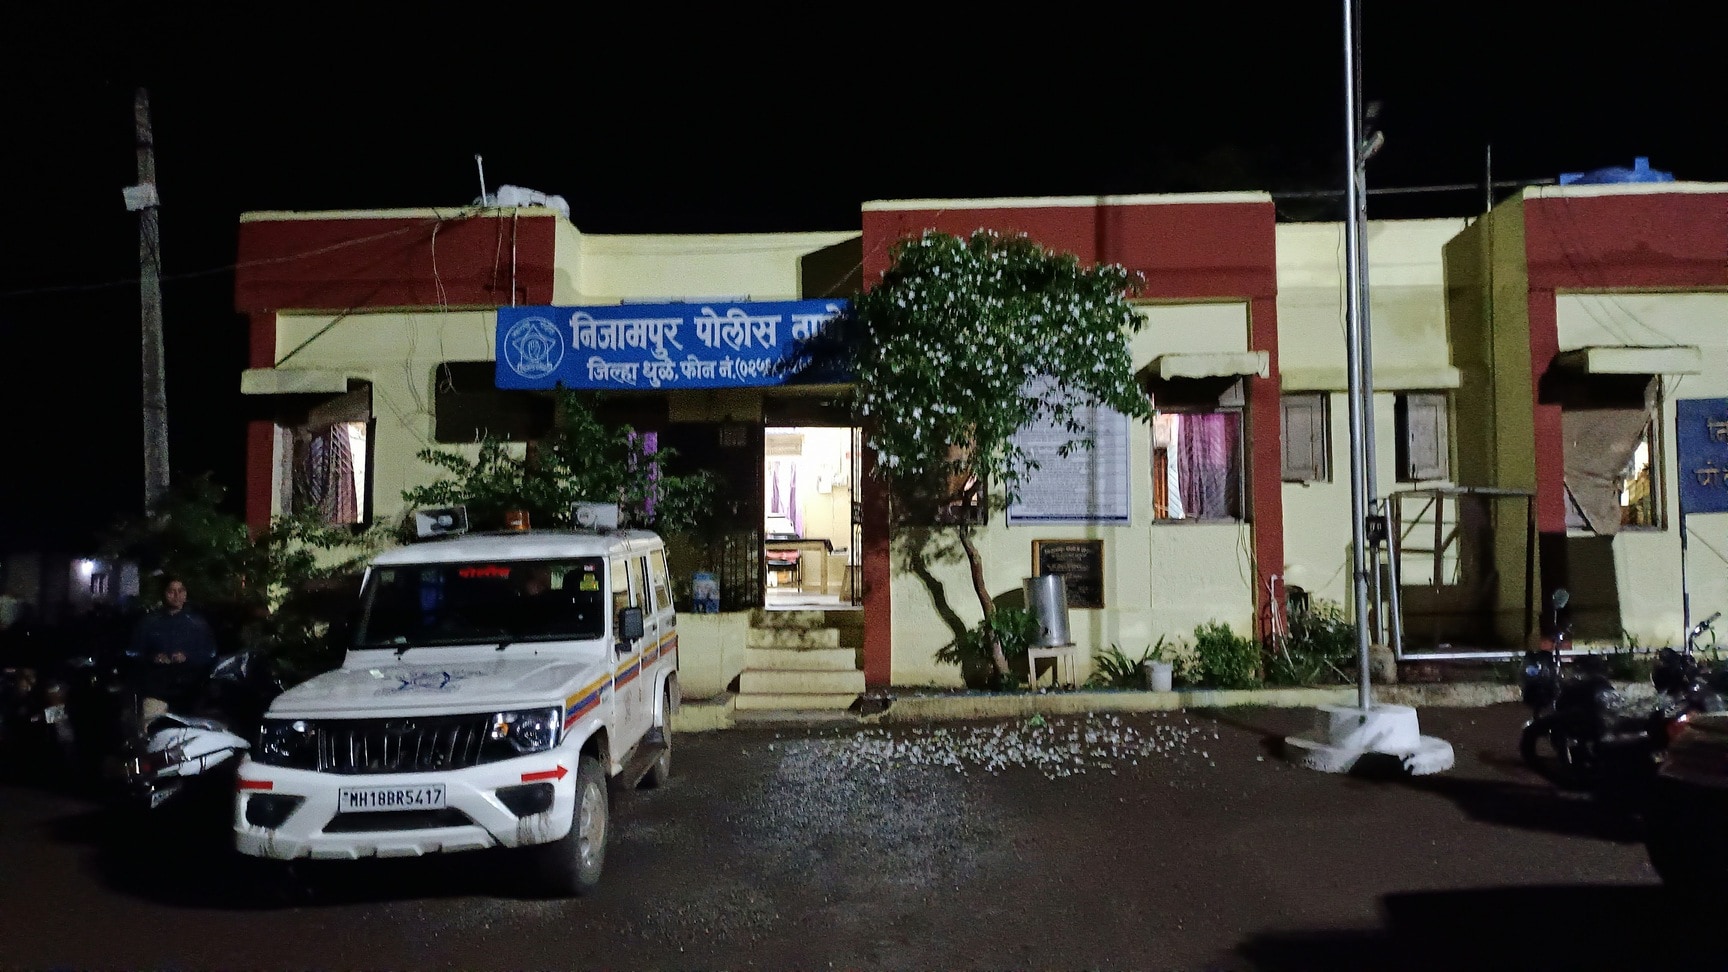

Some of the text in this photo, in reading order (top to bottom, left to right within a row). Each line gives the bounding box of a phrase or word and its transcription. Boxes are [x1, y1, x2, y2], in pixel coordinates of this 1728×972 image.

[694, 306, 782, 351] पोलीस
[587, 355, 640, 386] जिल्हा
[680, 354, 715, 380] फोन
[350, 789, 442, 807] MH18BR5417
